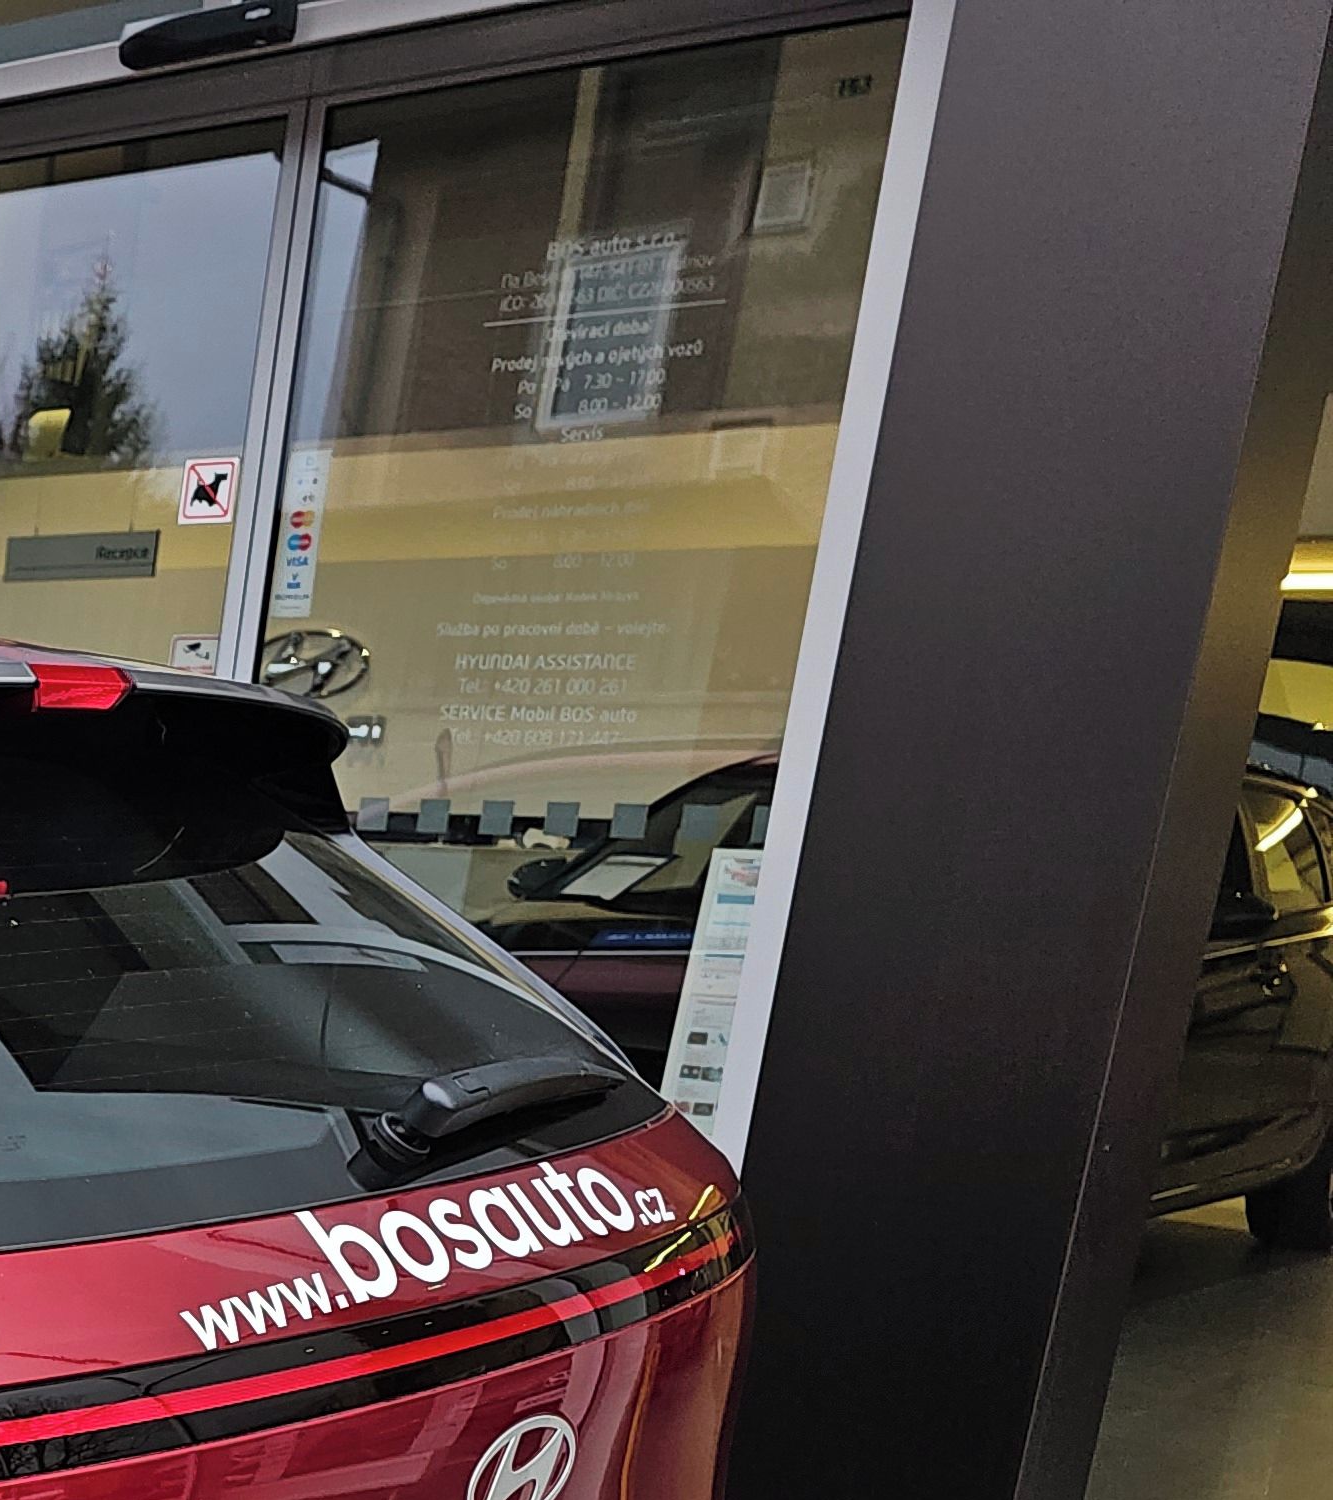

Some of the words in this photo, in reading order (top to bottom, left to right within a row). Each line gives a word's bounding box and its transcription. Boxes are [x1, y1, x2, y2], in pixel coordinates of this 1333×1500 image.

[590, 233, 631, 256] auto
[491, 355, 537, 374] Prodej
[608, 344, 664, 366] ojetých
[668, 337, 705, 357] vozů
[517, 379, 536, 395] Po
[514, 403, 533, 419] So
[560, 424, 604, 443] Servis
[286, 556, 309, 566] VISA
[482, 625, 500, 640] po
[503, 621, 563, 639] pracovní
[454, 653, 529, 671] HYUNDAI
[532, 652, 638, 671] ASSISTANCE
[493, 677, 531, 696] +420
[533, 678, 560, 696] 261
[566, 677, 596, 696] 000
[438, 704, 507, 722] SERVICE
[510, 704, 557, 722] Mobil
[559, 704, 596, 723] BOS
[599, 706, 638, 724] auto
[180, 1161, 676, 1351] www.bosauto.cz
